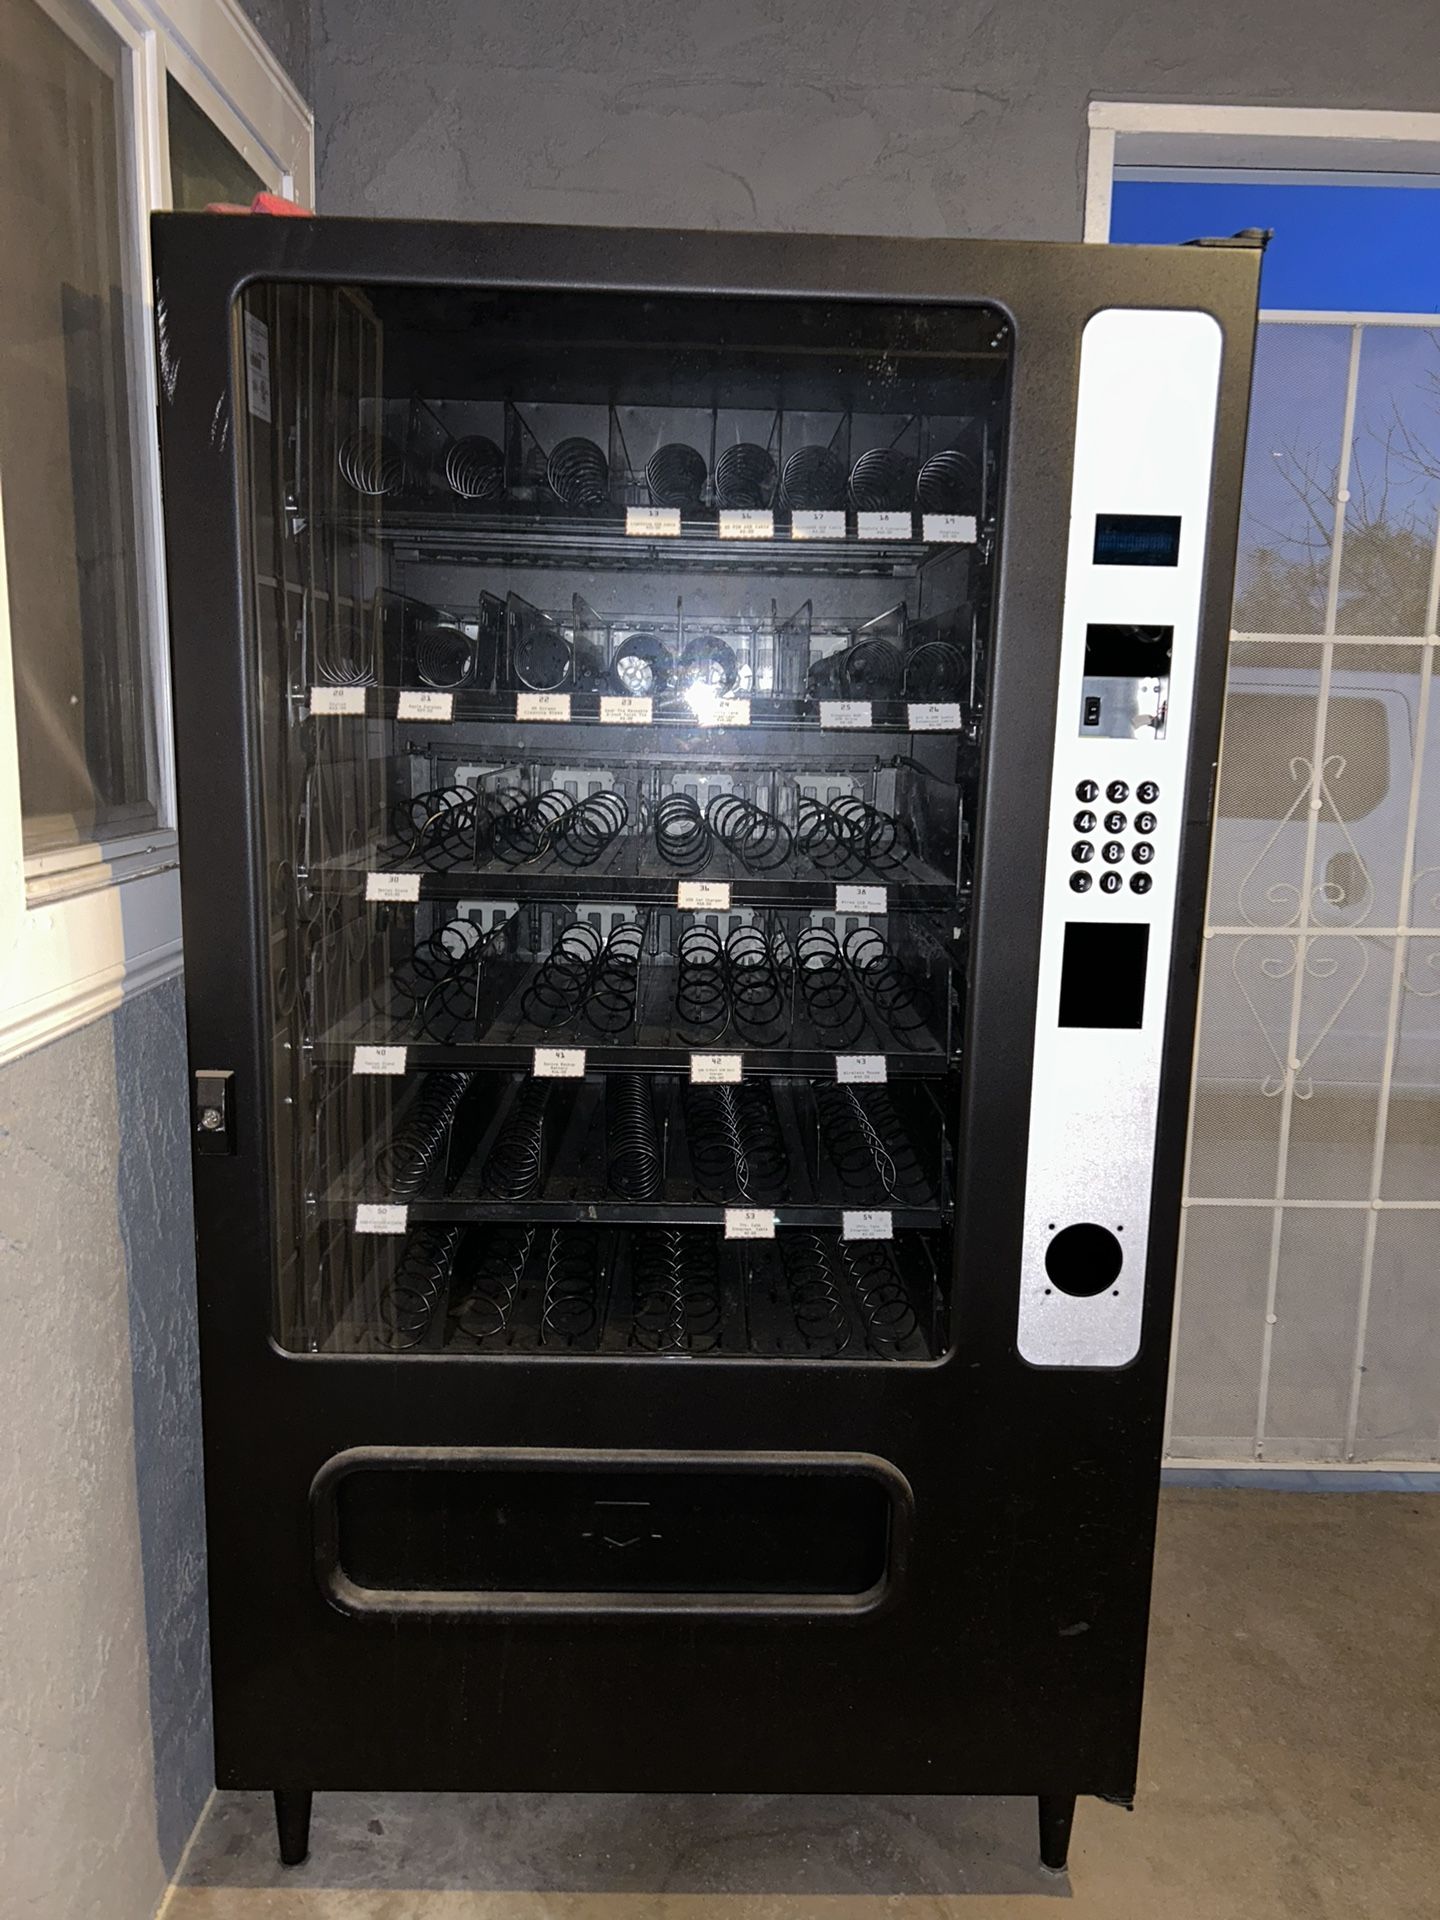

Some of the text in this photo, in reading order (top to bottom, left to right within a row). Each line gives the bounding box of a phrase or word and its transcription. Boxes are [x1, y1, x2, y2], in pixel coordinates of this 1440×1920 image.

[1084, 784, 1091, 799] 1
[1114, 785, 1123, 799] 2
[1143, 785, 1154, 800] 3
[1080, 814, 1090, 829] 4
[1111, 815, 1120, 830] 5
[1141, 816, 1151, 830] 6
[1080, 845, 1089, 859] 7
[1109, 845, 1118, 860] 8
[1139, 846, 1149, 861] 9
[1107, 875, 1116, 890] 0
[555, 1051, 565, 1059] 41
[711, 1057, 721, 1065] 42
[856, 1057, 866, 1065] 43
[377, 1207, 388, 1215] 50
